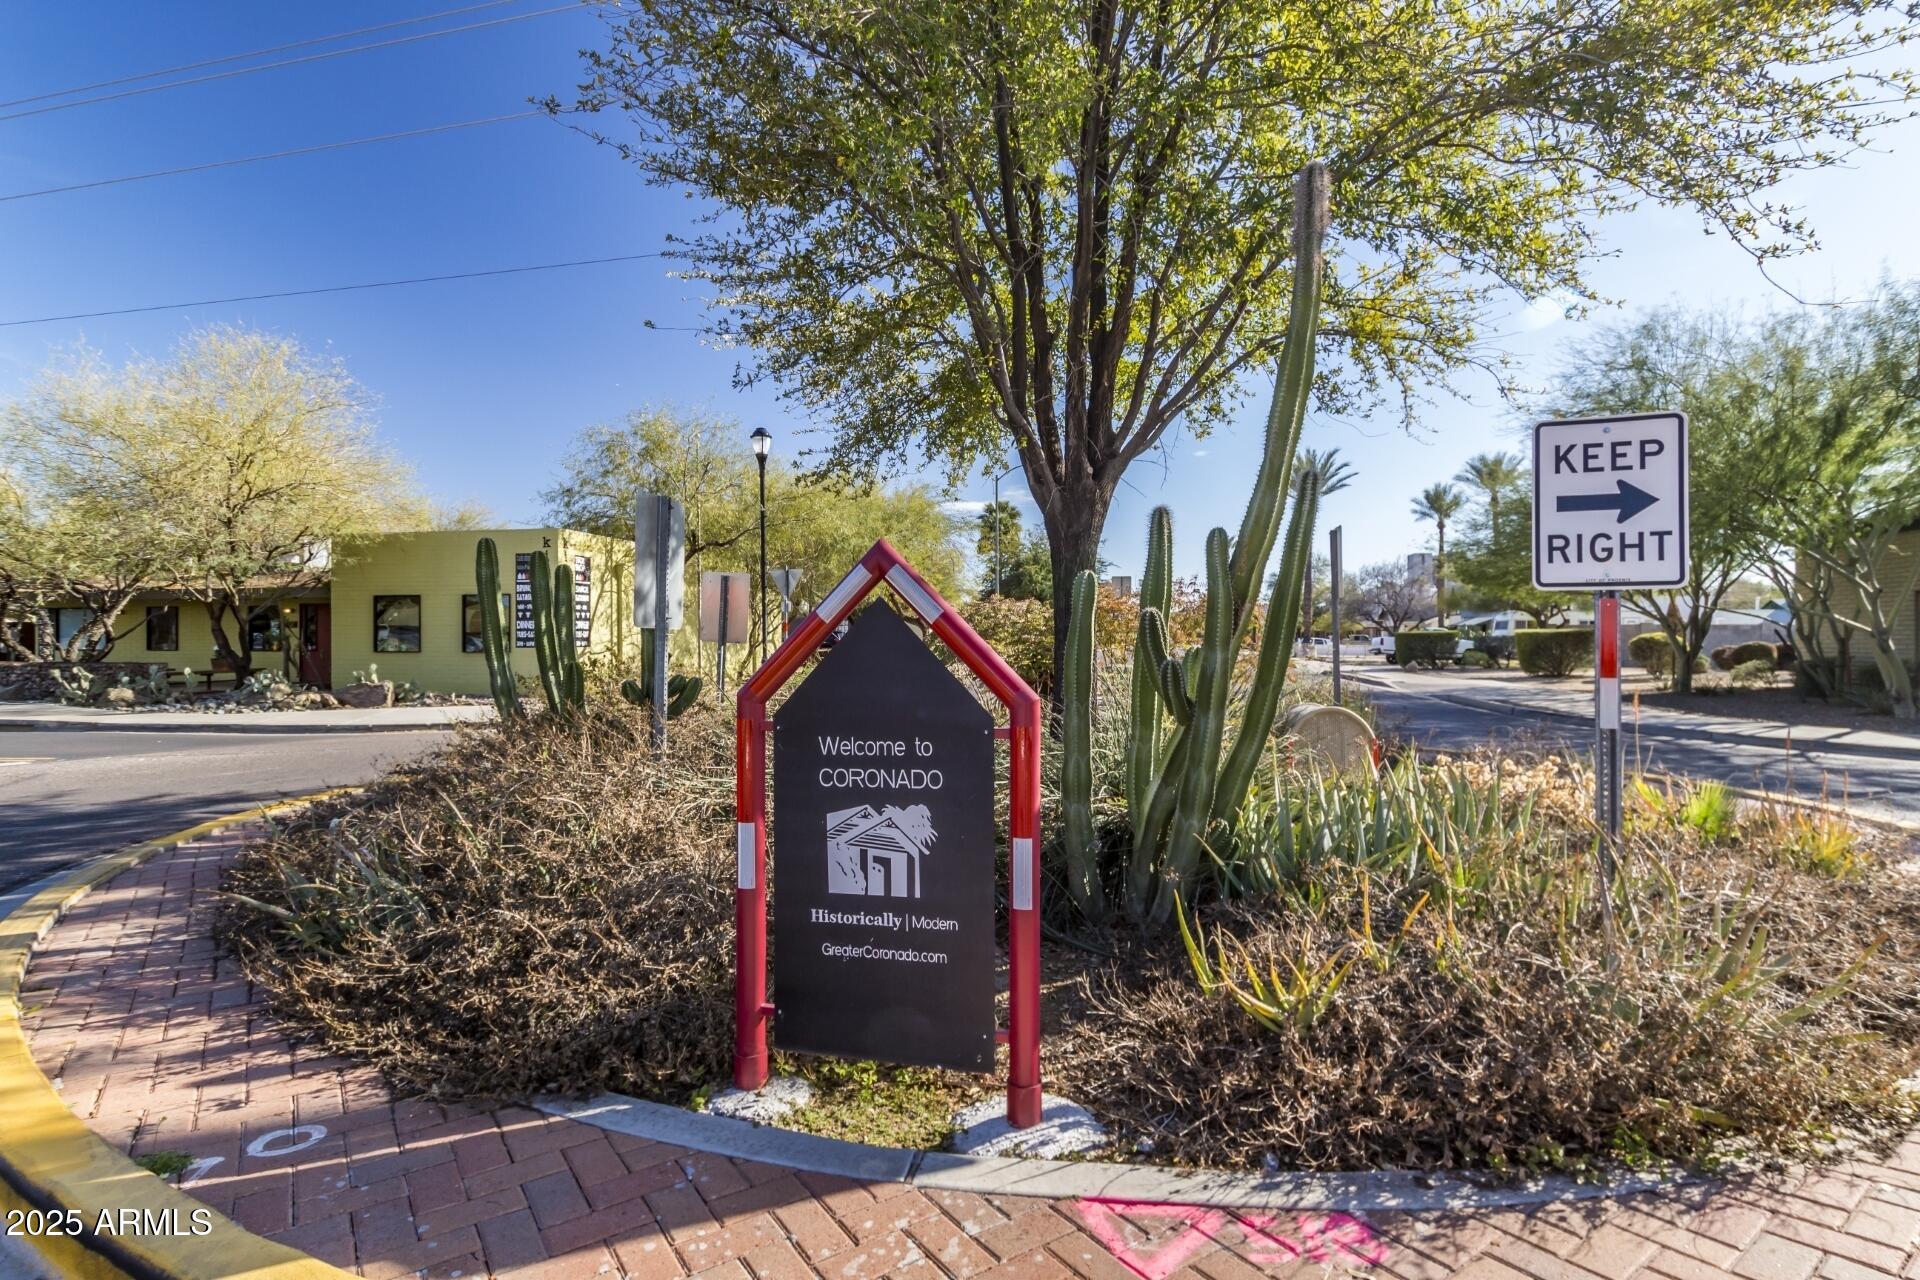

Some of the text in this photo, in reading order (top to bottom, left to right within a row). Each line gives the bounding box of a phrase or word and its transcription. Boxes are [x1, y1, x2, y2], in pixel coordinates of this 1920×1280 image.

[1554, 439, 1665, 475] KEEP
[1547, 530, 1673, 564] RIGHT
[818, 736, 934, 757] Welcome to
[819, 767, 944, 790] CORONADO
[810, 908, 959, 931] Historically Modern
[821, 942, 948, 964] GreaterCoronado.com
